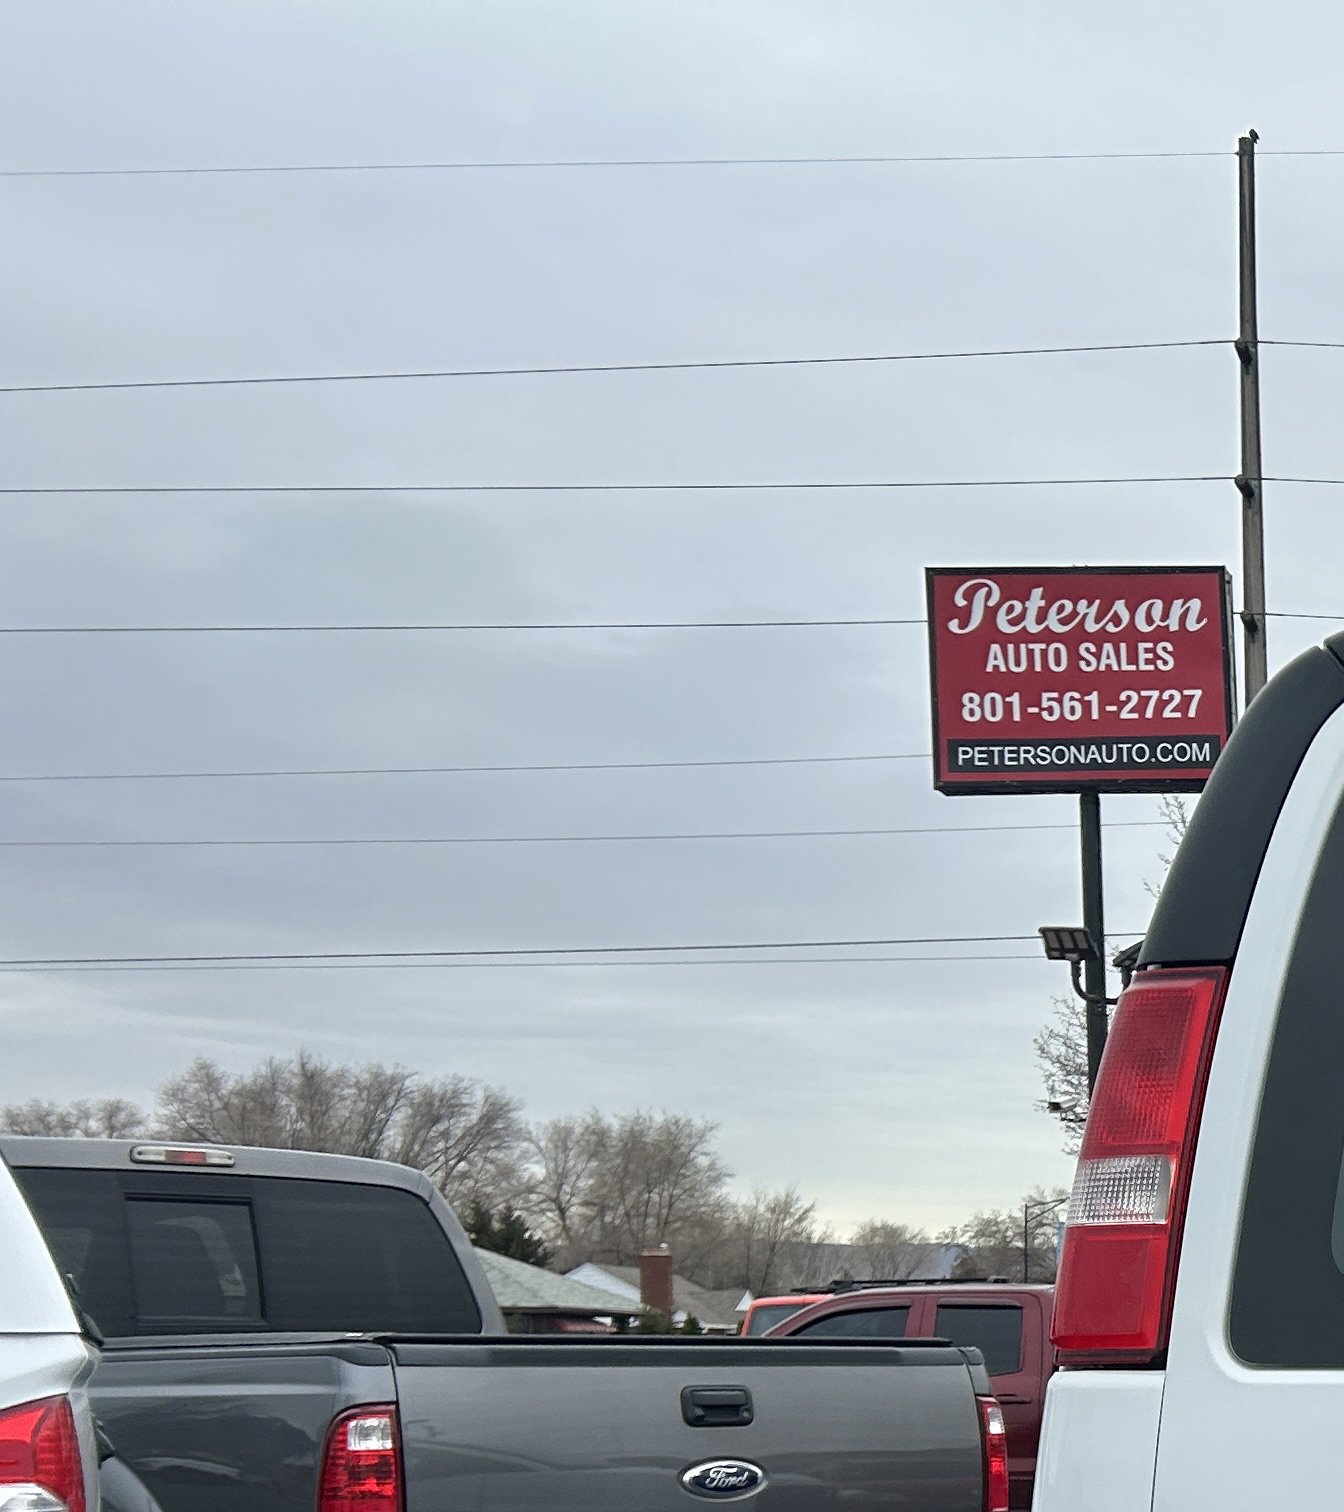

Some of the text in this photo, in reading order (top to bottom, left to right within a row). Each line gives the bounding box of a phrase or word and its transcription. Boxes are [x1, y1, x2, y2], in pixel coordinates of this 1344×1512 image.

[947, 578, 1208, 635] Peterson
[985, 641, 1175, 672] AUTO SALES
[961, 689, 1203, 722] 801-561-2727
[957, 742, 1211, 766] PETERSONAUTO.COM
[705, 1466, 749, 1489] Ford
